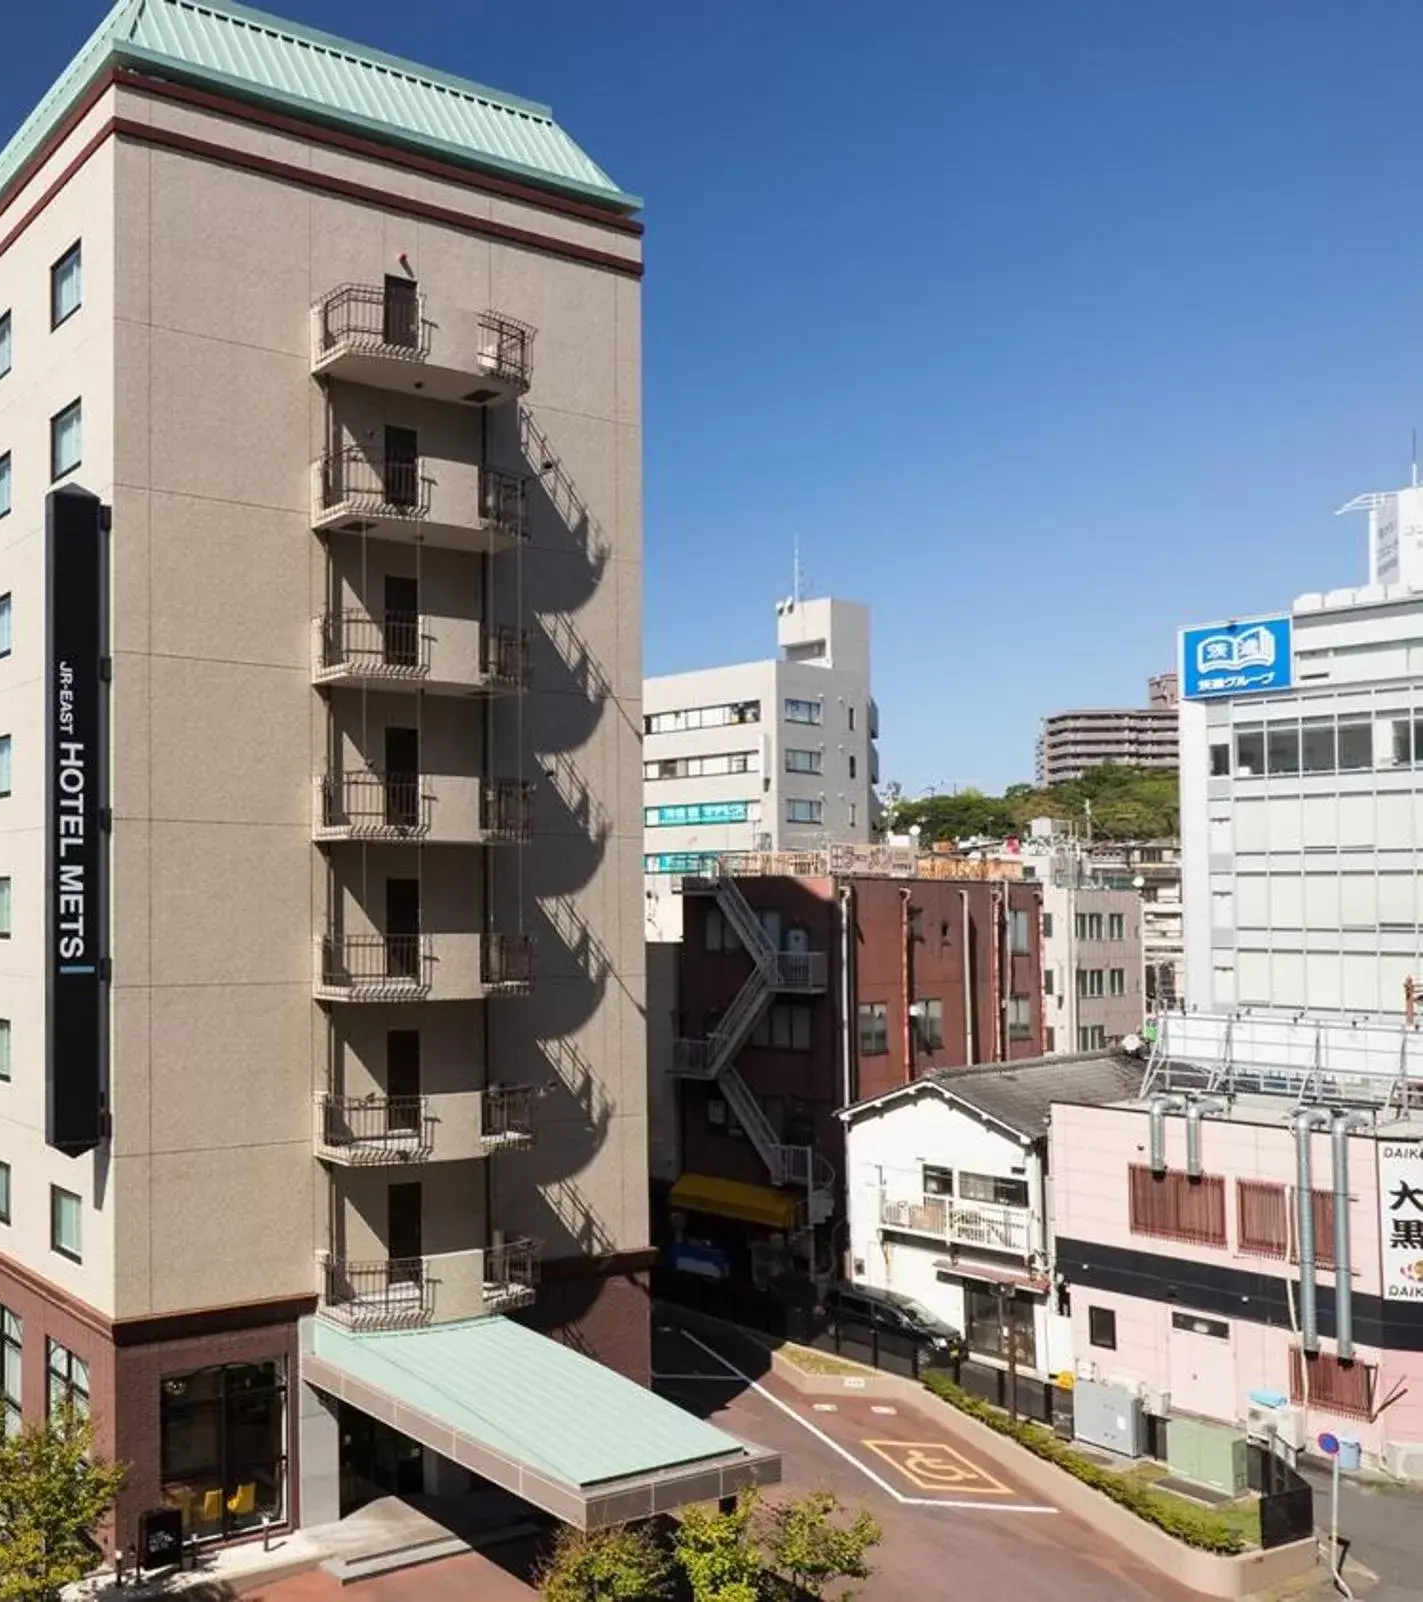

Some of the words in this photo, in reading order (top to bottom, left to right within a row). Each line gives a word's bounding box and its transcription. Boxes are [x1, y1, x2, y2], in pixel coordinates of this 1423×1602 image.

[59, 661, 74, 735] JR-EAST
[59, 742, 84, 857] HOTEL
[59, 865, 84, 959] METS
[1384, 1147, 1423, 1160] DAIK
